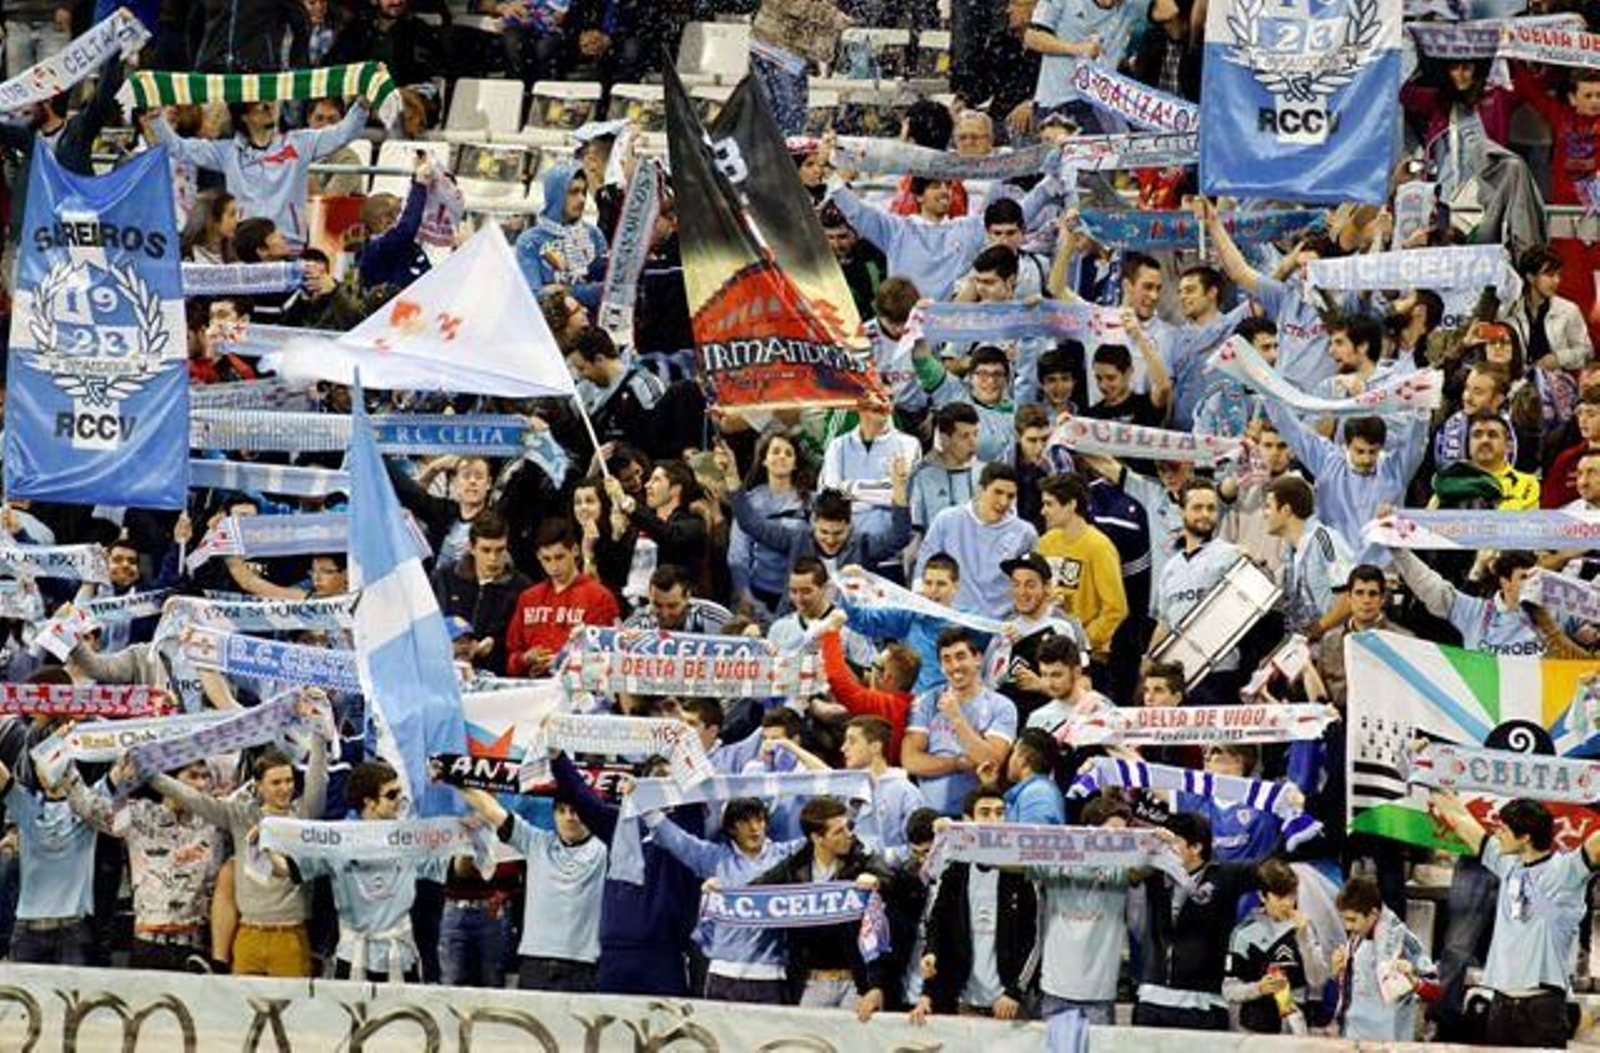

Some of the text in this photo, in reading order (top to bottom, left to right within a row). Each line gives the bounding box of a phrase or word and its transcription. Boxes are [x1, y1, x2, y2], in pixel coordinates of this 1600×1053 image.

[55, 412, 138, 441] RCCV
[438, 426, 504, 443] CELTA
[683, 659, 705, 678] DE
[1196, 709, 1218, 726] DE
[1469, 757, 1570, 792] CELTA
[301, 827, 342, 846] club
[708, 888, 864, 918] R.C. CELTA
